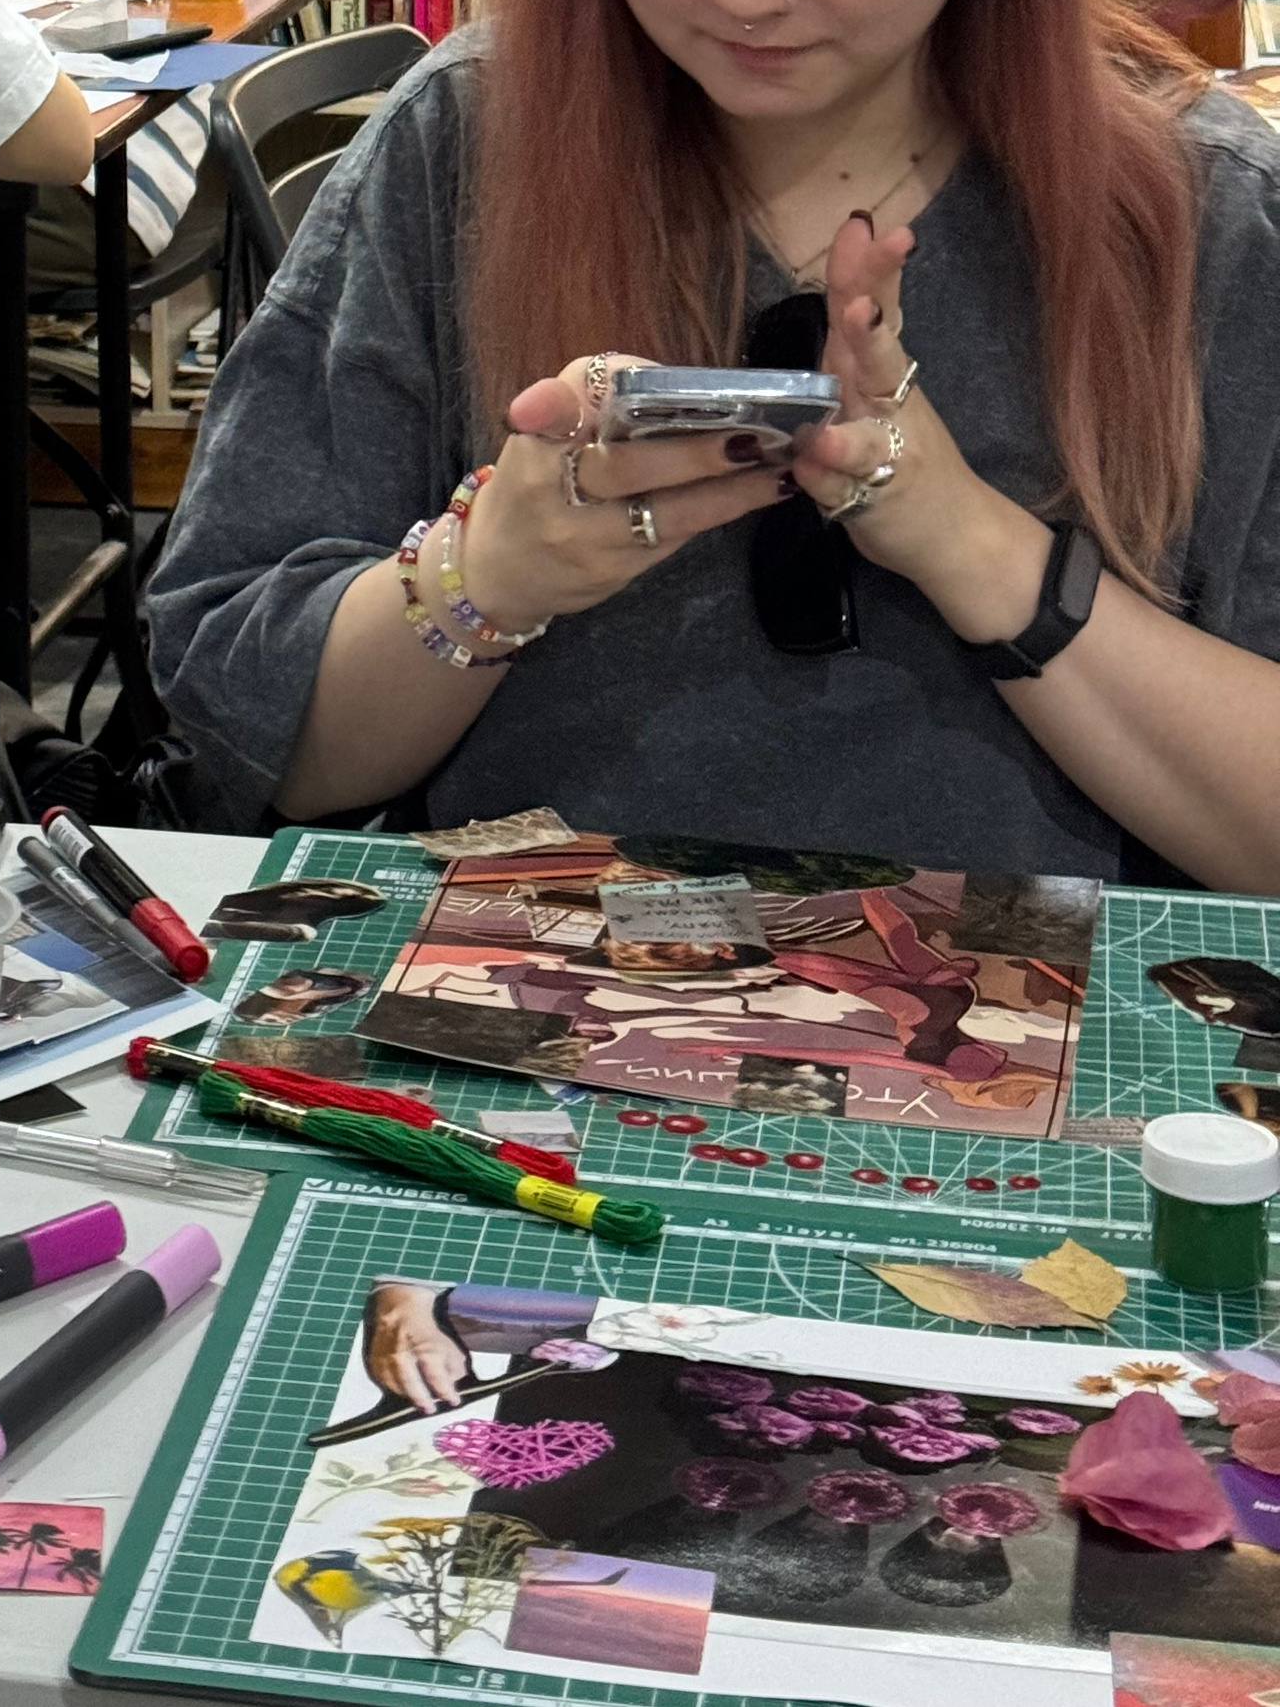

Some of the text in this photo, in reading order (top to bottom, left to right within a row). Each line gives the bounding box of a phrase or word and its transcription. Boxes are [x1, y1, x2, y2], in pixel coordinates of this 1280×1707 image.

[336, 1181, 468, 1205] BRAUBERG
[703, 1218, 998, 1254] A3 3-layer art. 236904
